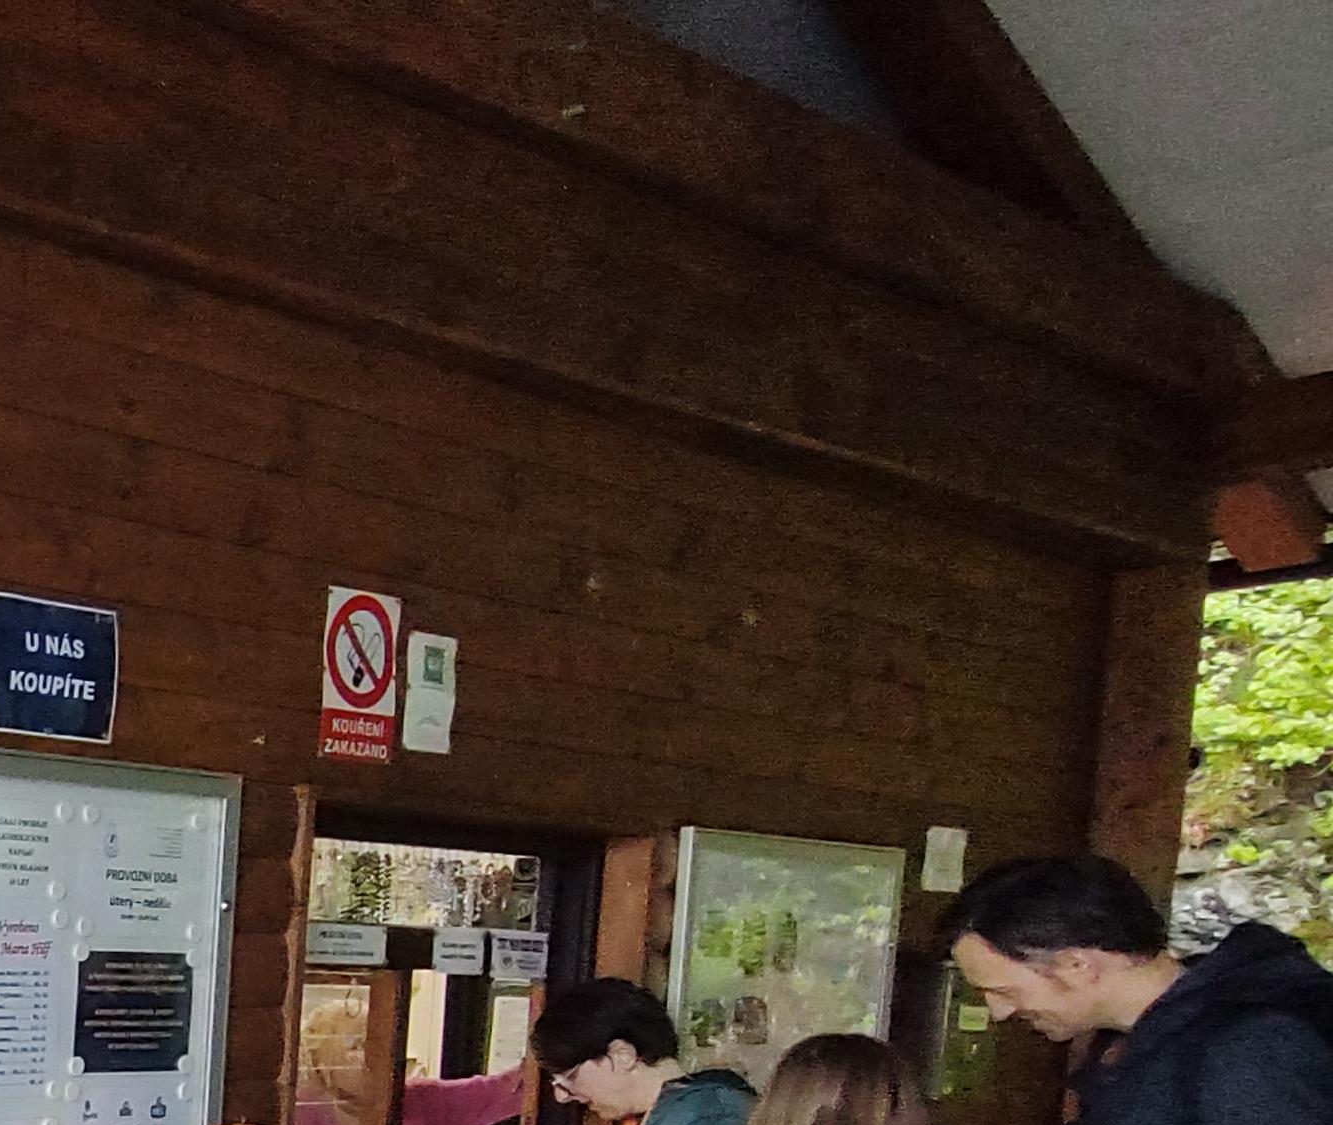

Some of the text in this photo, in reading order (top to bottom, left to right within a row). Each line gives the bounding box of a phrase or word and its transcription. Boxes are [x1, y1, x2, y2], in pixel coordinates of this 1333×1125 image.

[25, 631, 85, 659] U NÁS
[9, 669, 96, 700] KOUPÍTE
[332, 717, 384, 737] KOUŘENÍ
